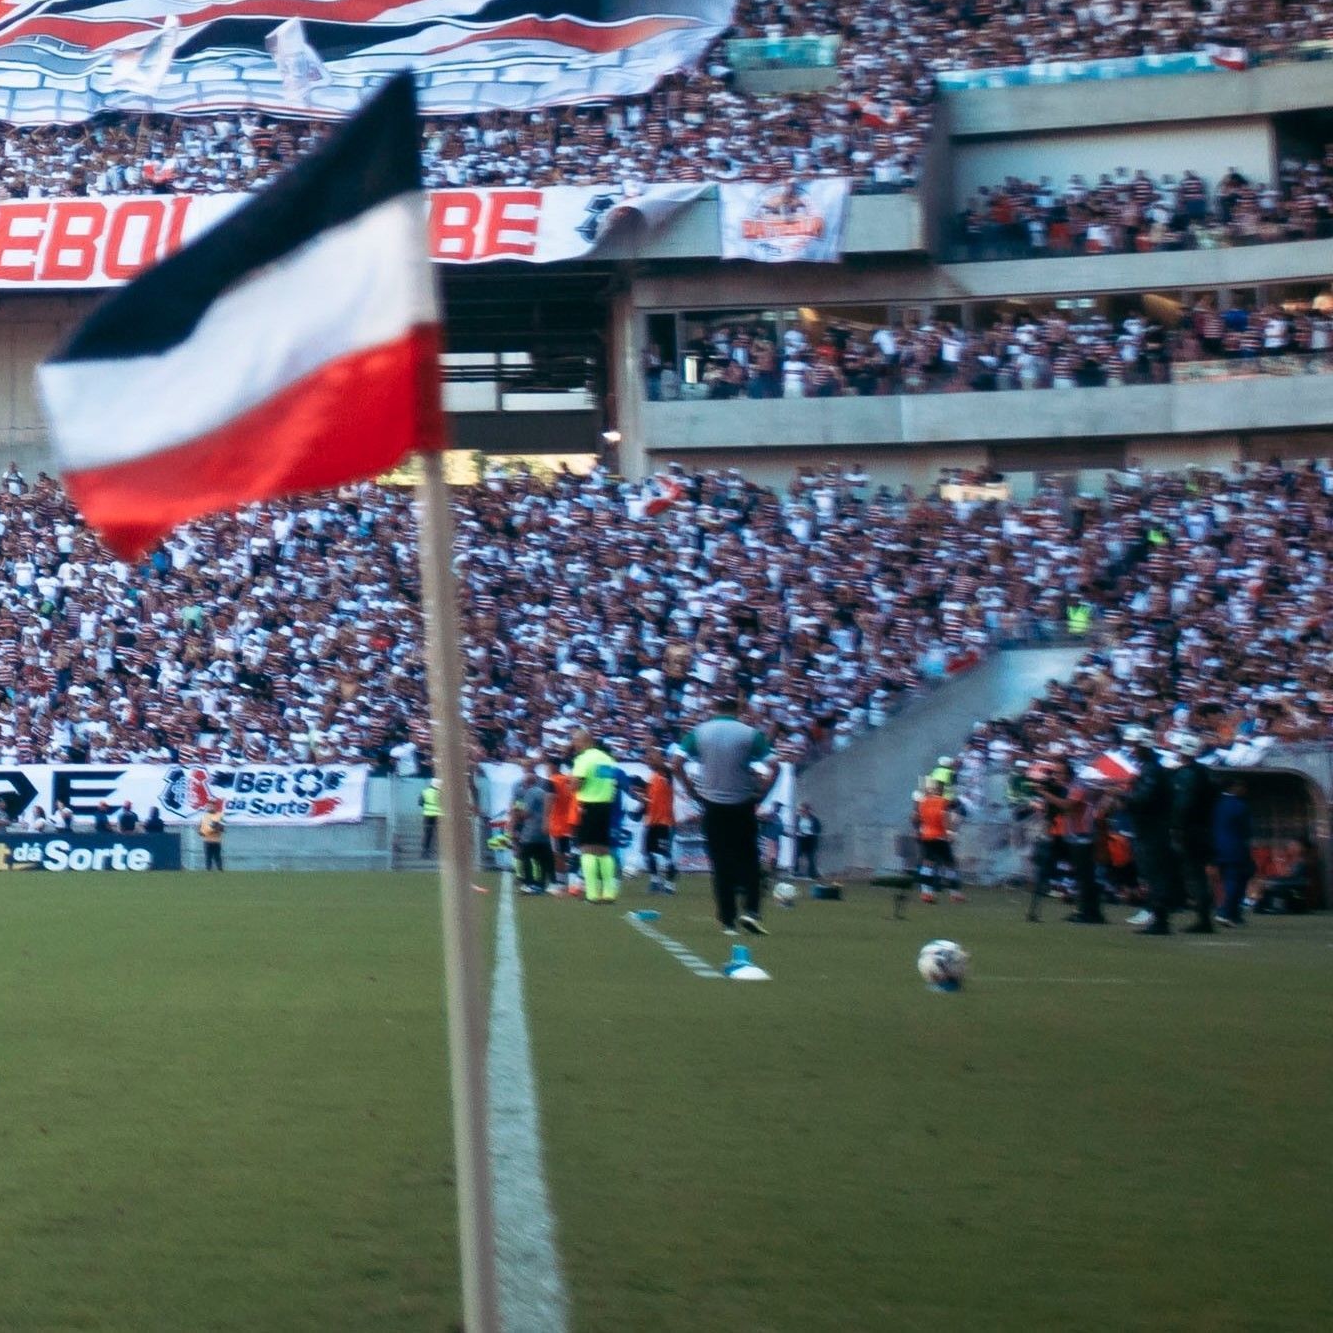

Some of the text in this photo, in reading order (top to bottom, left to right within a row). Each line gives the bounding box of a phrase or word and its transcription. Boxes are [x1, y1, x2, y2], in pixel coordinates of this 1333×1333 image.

[235, 770, 288, 794] Bet
[250, 798, 310, 816] Sorte
[42, 839, 152, 872] Sorte
